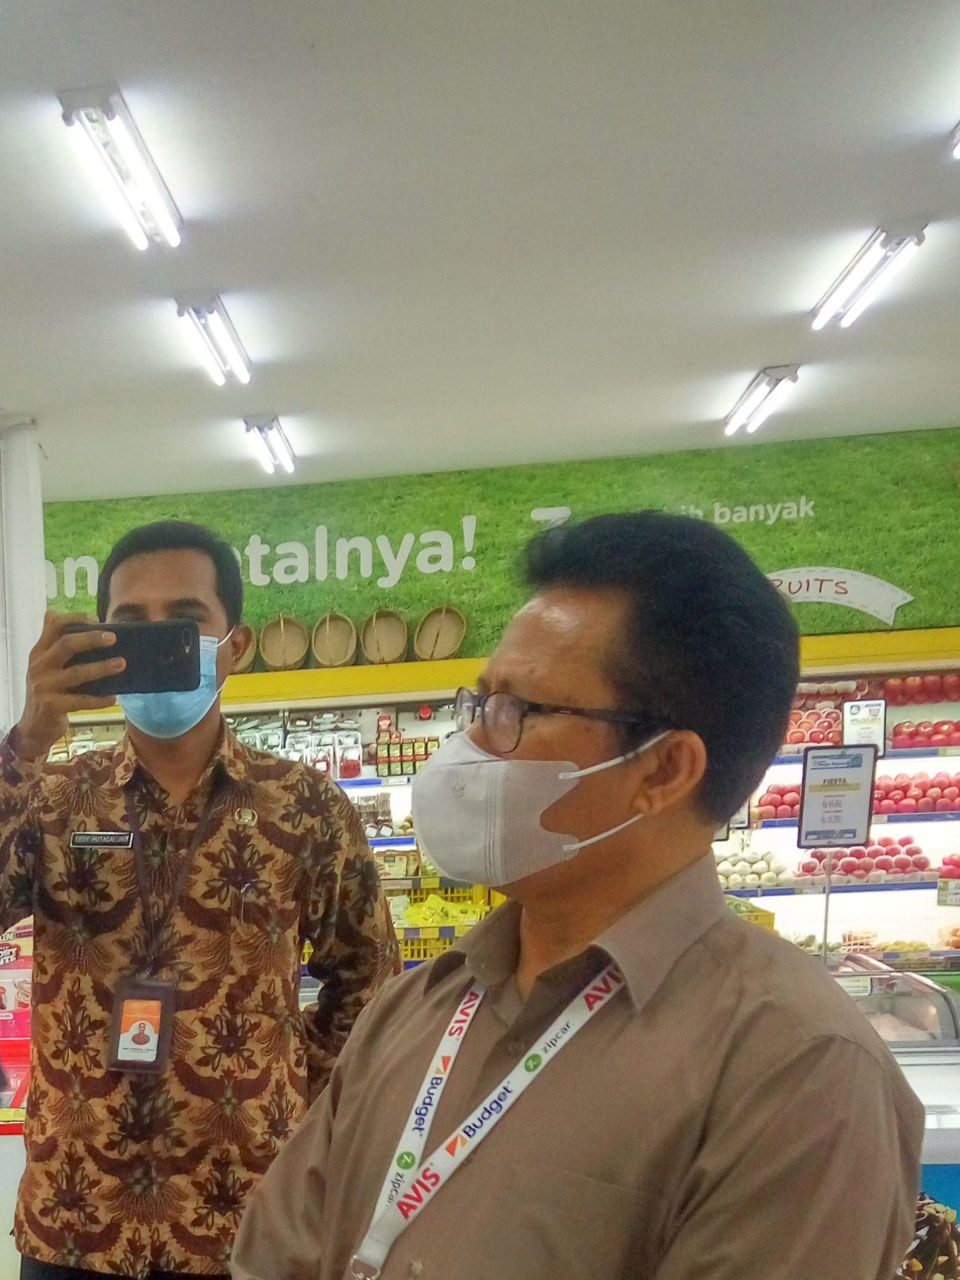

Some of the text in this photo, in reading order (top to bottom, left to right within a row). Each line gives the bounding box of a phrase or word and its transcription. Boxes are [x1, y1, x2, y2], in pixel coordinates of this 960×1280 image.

[713, 496, 815, 525] banyak
[232, 515, 477, 588] talnya!
[448, 991, 480, 1037] AVIS
[396, 965, 623, 1220] AVIS Budget zipcar AVI
[412, 1076, 443, 1132] Budget
